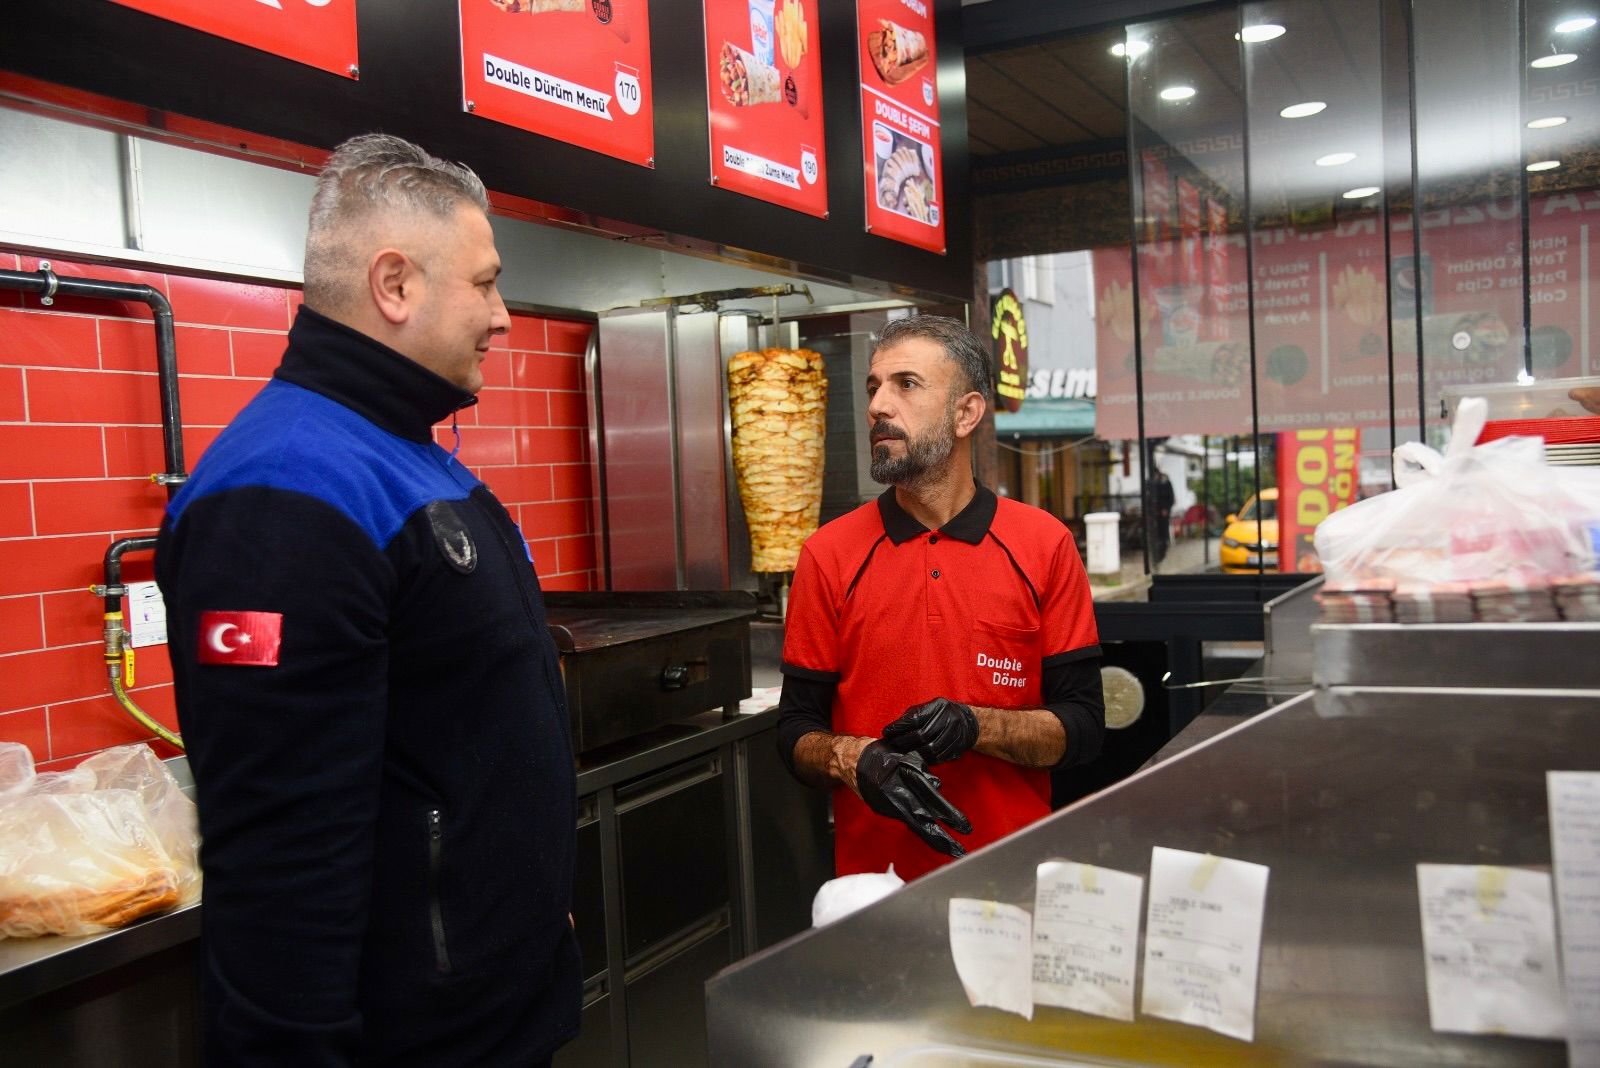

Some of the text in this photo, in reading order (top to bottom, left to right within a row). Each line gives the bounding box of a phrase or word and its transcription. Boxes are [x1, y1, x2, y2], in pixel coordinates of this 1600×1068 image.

[485, 61, 606, 113] Double Dürüm Menü
[619, 80, 638, 101] 170
[875, 99, 908, 128] DOUBLE
[724, 150, 745, 168] Double
[977, 653, 1022, 671] Double
[993, 672, 1027, 688] Döner
